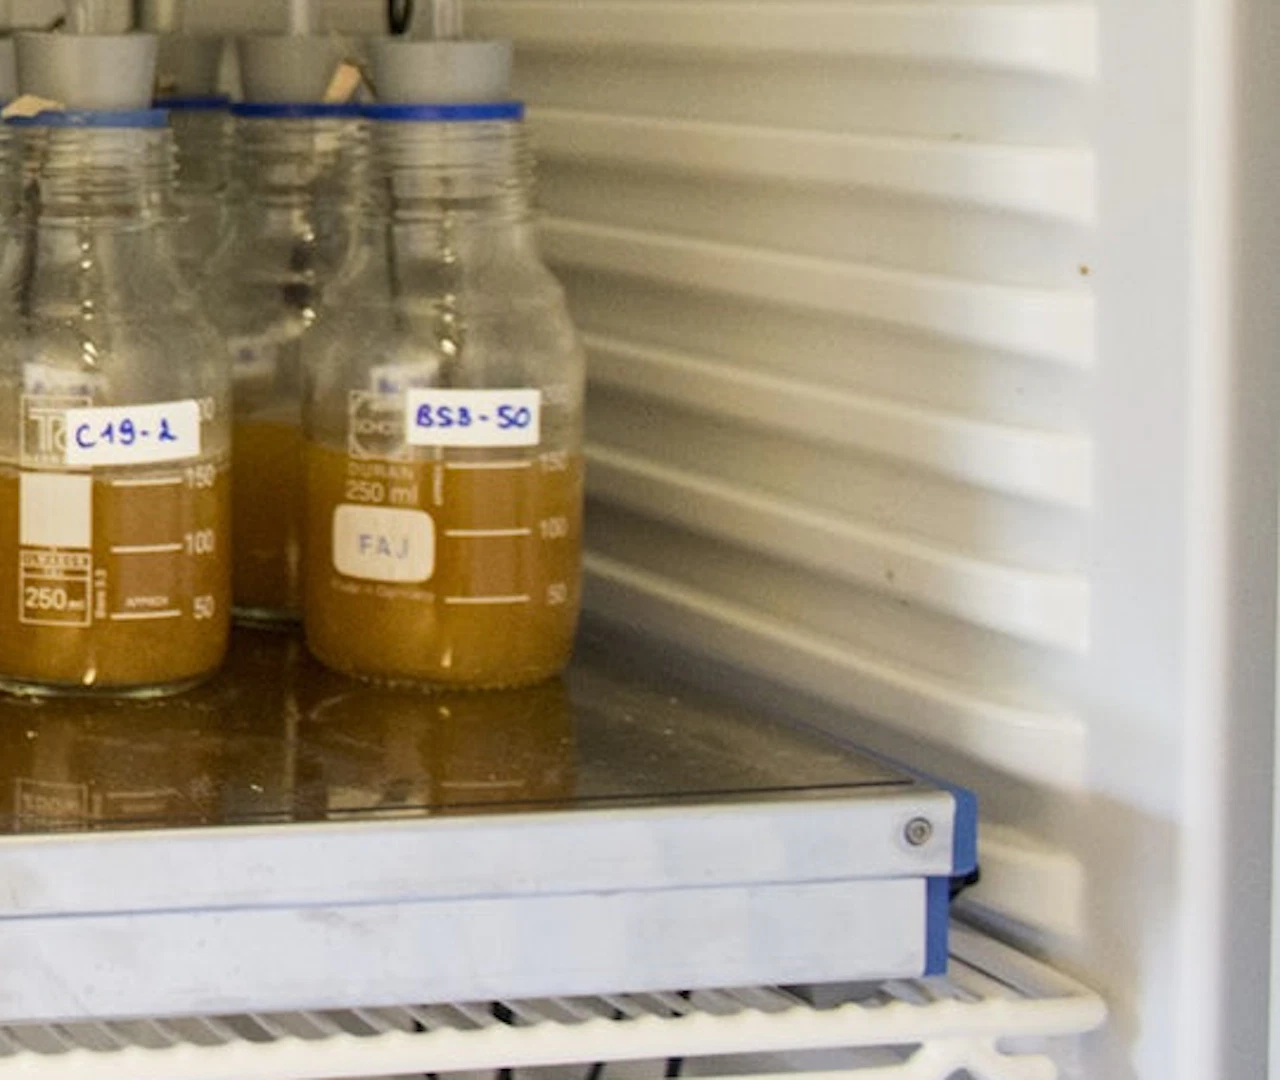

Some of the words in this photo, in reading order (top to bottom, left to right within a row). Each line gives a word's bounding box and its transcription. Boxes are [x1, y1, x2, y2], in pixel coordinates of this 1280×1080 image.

[75, 418, 178, 449] C19-2
[345, 480, 385, 503] 250
[390, 482, 419, 503] ml
[184, 529, 215, 555] 100
[24, 586, 67, 611] 250
[193, 595, 215, 620] 50
